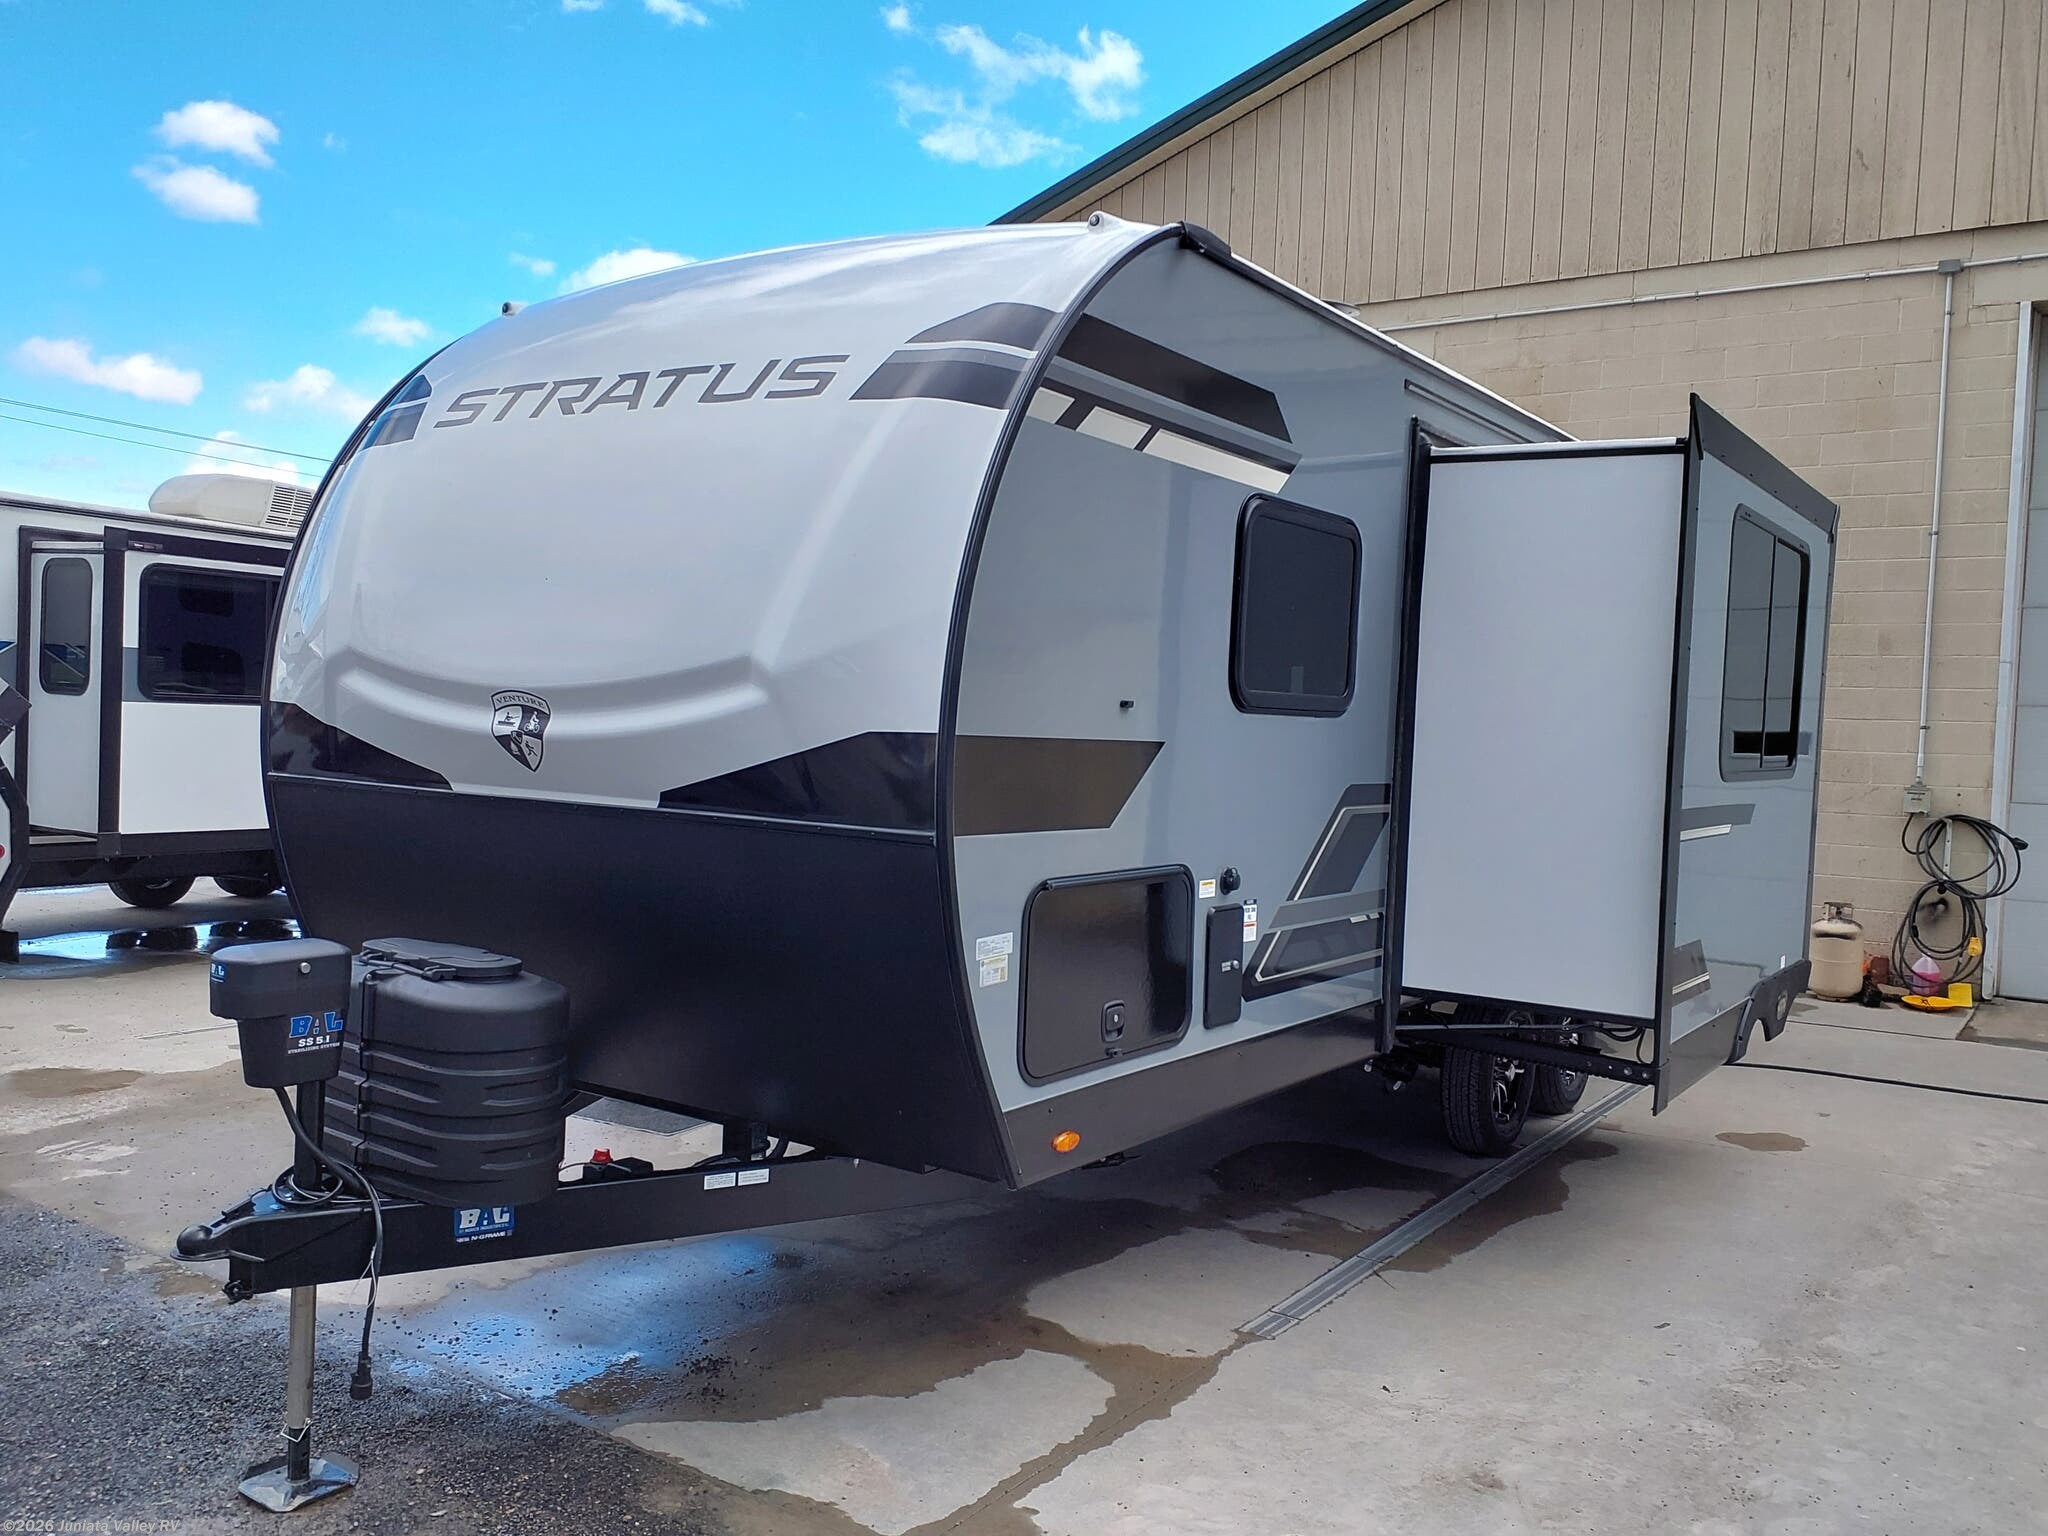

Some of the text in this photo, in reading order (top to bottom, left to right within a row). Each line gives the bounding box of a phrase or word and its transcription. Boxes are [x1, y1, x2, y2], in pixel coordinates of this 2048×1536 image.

[433, 354, 851, 428] STRATUS
[496, 694, 545, 709] VENTURE
[289, 1011, 344, 1038] BAL
[298, 1037, 314, 1047] SS
[459, 1207, 510, 1229] BAL
